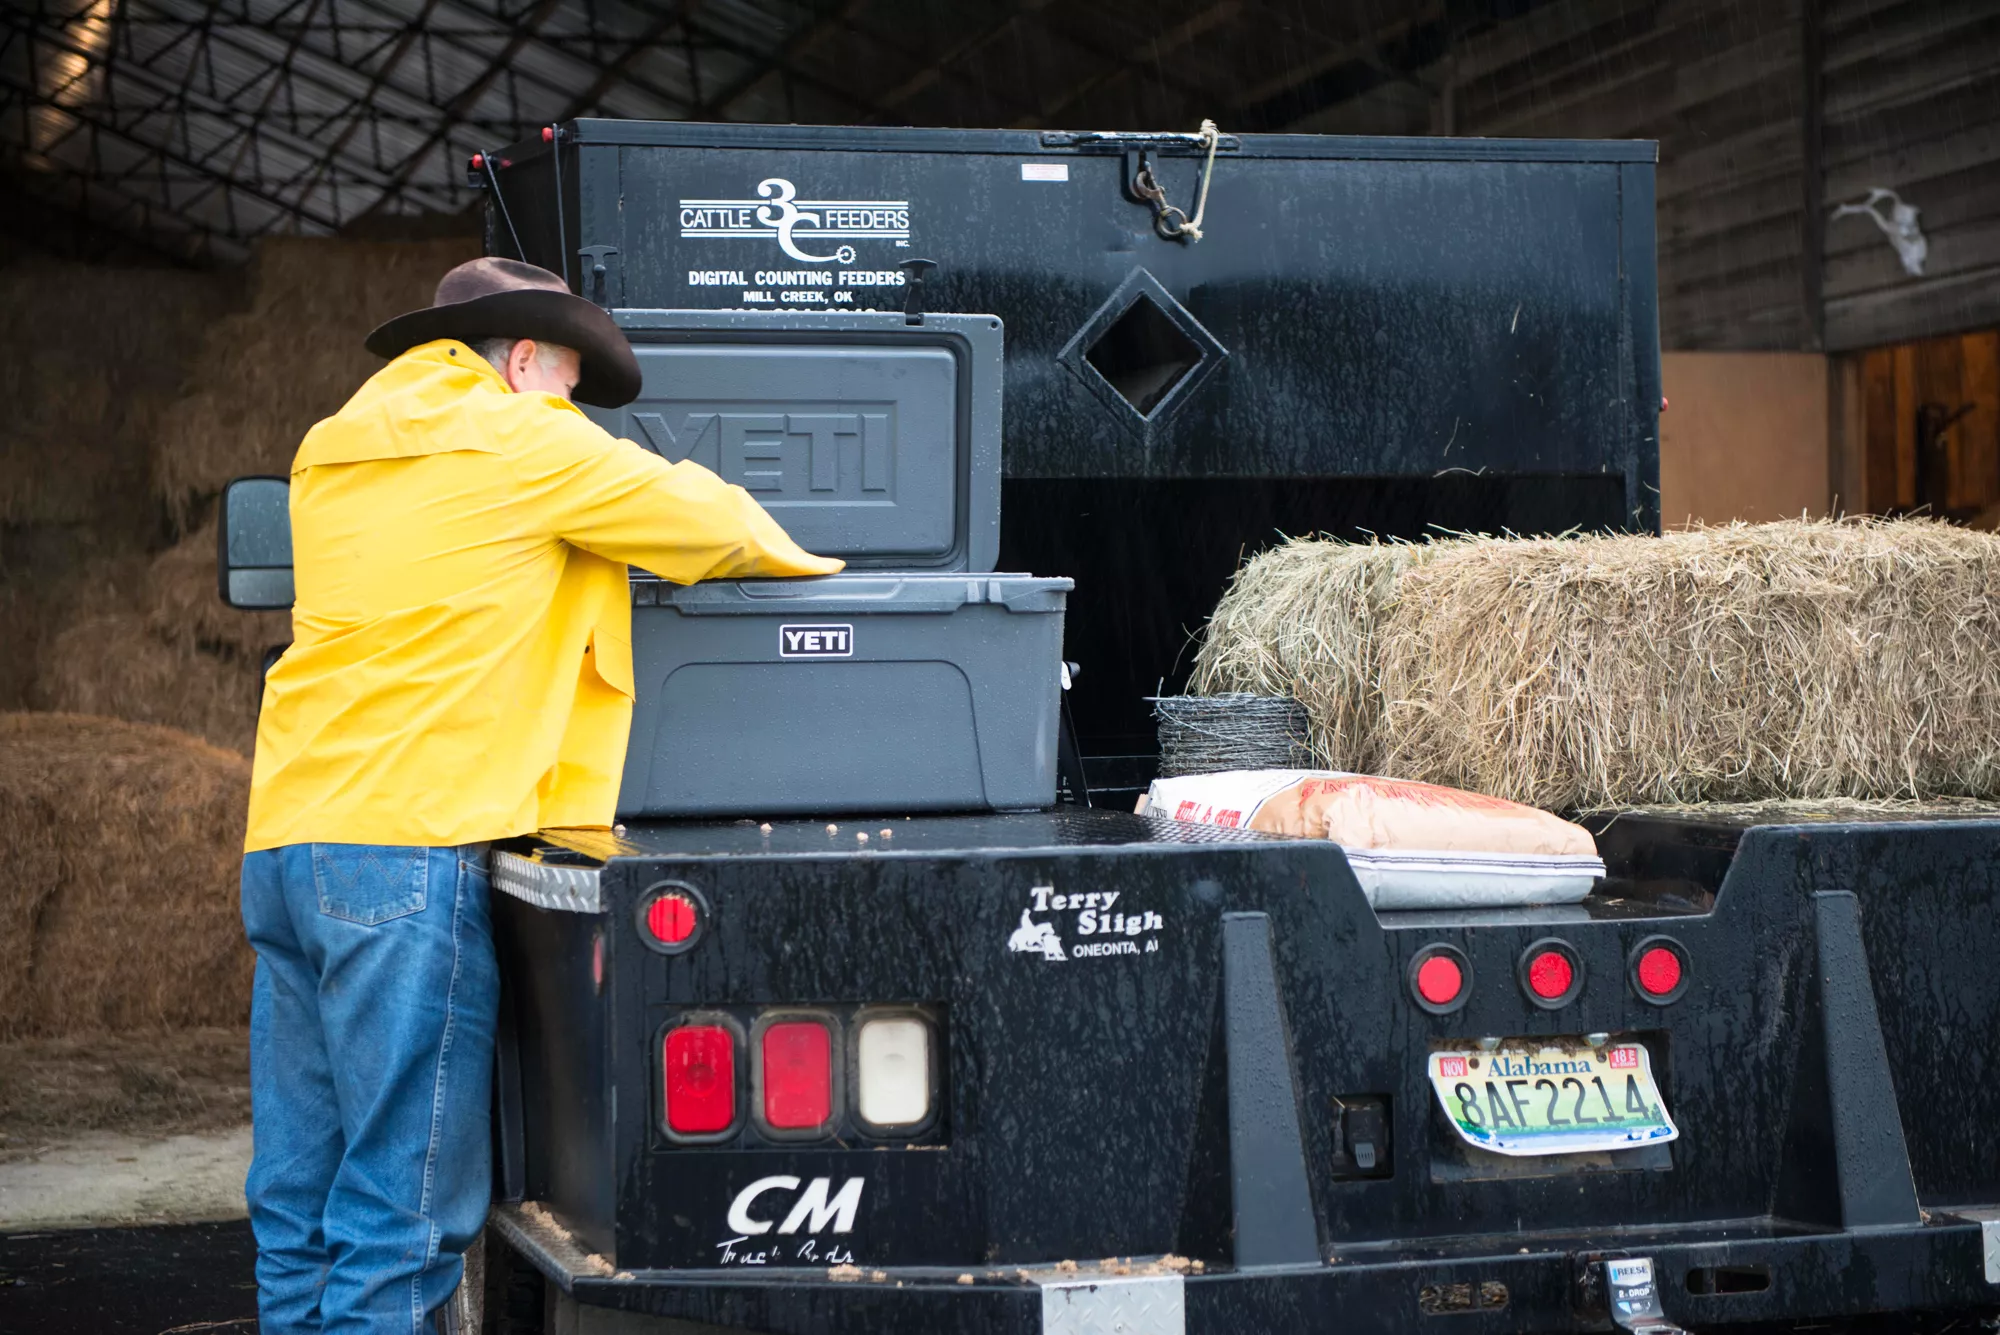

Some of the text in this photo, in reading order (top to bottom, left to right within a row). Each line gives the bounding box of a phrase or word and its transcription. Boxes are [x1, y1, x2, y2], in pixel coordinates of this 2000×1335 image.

[680, 209, 751, 228] CATTLE
[826, 210, 909, 229] FEEDERS
[688, 270, 905, 286] DIGITAL COUNTING FEEDERS
[743, 291, 853, 304] MILL CREEK, OK
[632, 413, 888, 492] YETI
[785, 631, 846, 650] YETI
[1030, 886, 1120, 912] Terry
[1077, 909, 1163, 936] Sligh
[1072, 940, 1141, 959] ONEONTA,
[1443, 1060, 1464, 1077] NOV
[1488, 1056, 1592, 1077] Alabama
[1613, 1049, 1627, 1063] 18
[1455, 1074, 1650, 1128] 8AF2214
[727, 1175, 865, 1234] CM
[1617, 1266, 1648, 1276] REESE
